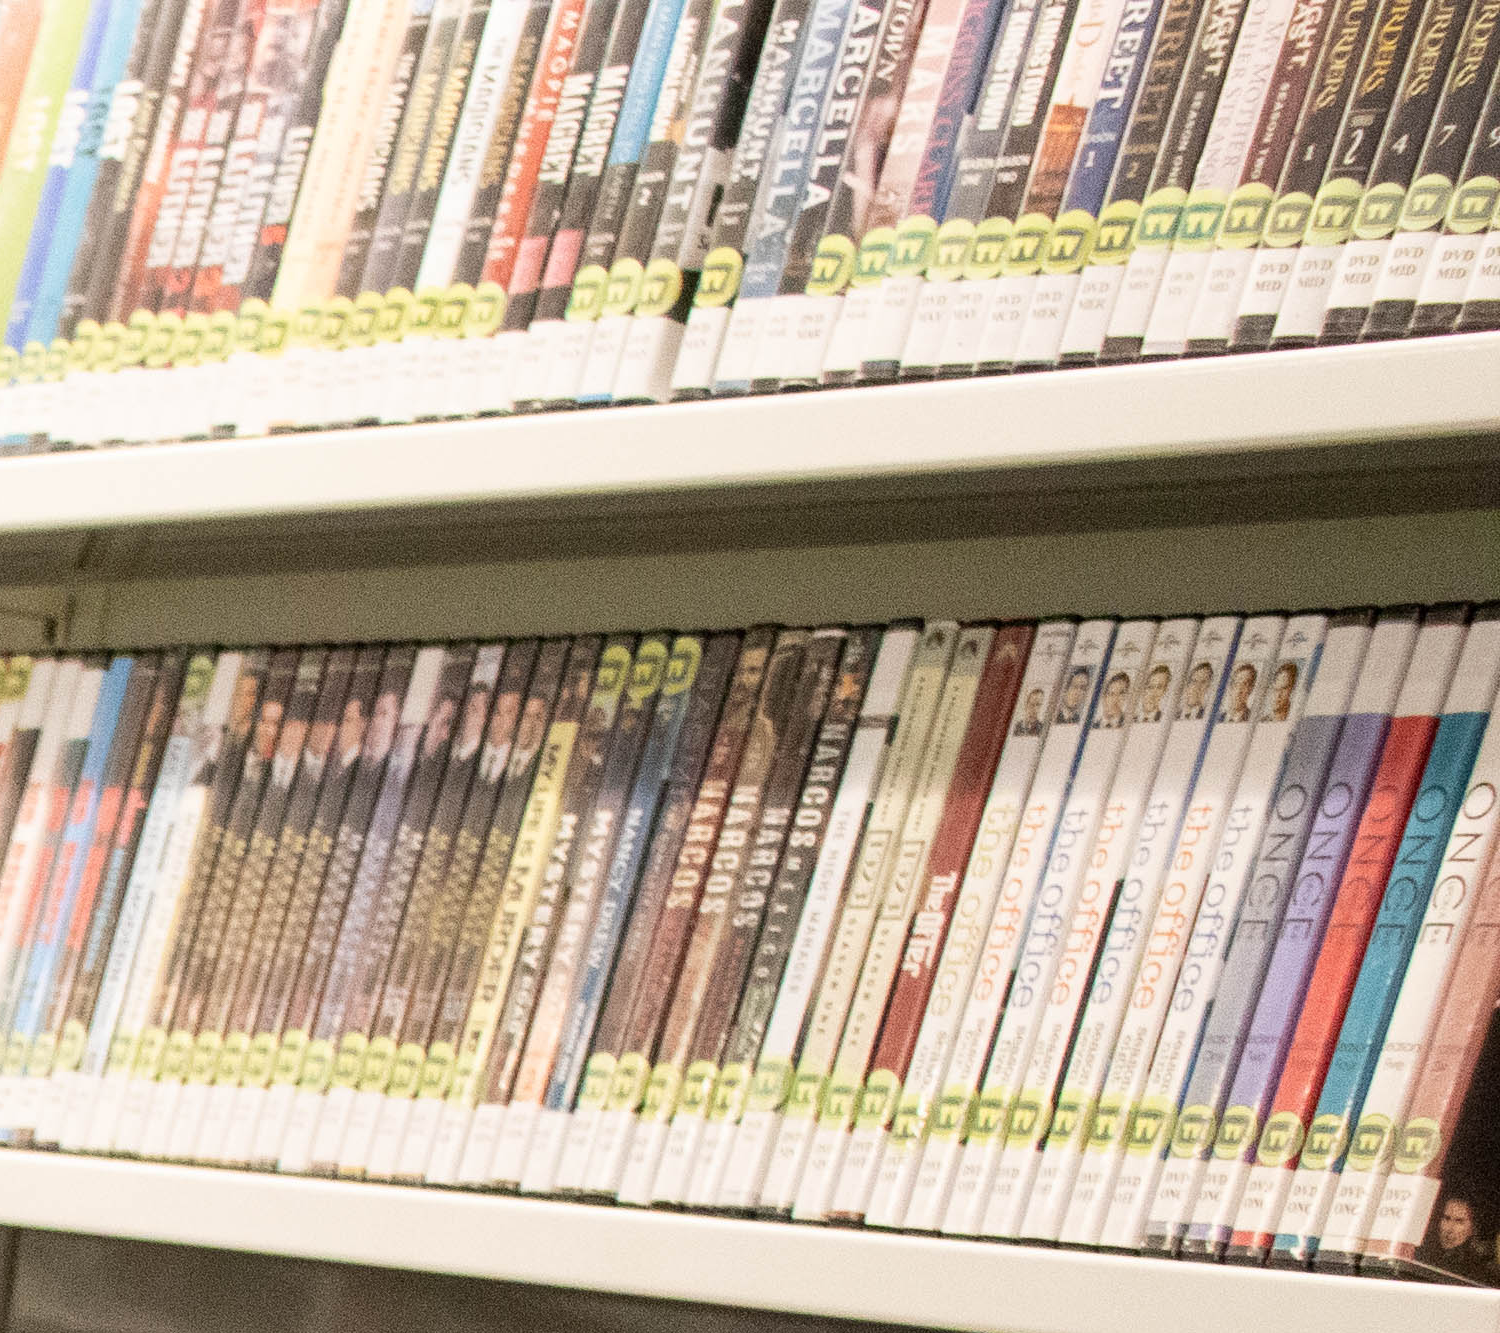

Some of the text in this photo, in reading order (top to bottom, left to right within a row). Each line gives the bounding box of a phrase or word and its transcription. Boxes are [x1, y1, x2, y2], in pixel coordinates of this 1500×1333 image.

[666, 778, 728, 909] NARCOS
[700, 785, 760, 914] NARCOS
[791, 722, 847, 847] NARCOS
[1420, 783, 1496, 945] ONCE
[974, 805, 1047, 1002] the office
[1052, 805, 1125, 1005] the office
[1132, 805, 1211, 1010] the office
[1174, 805, 1252, 1013] the office
